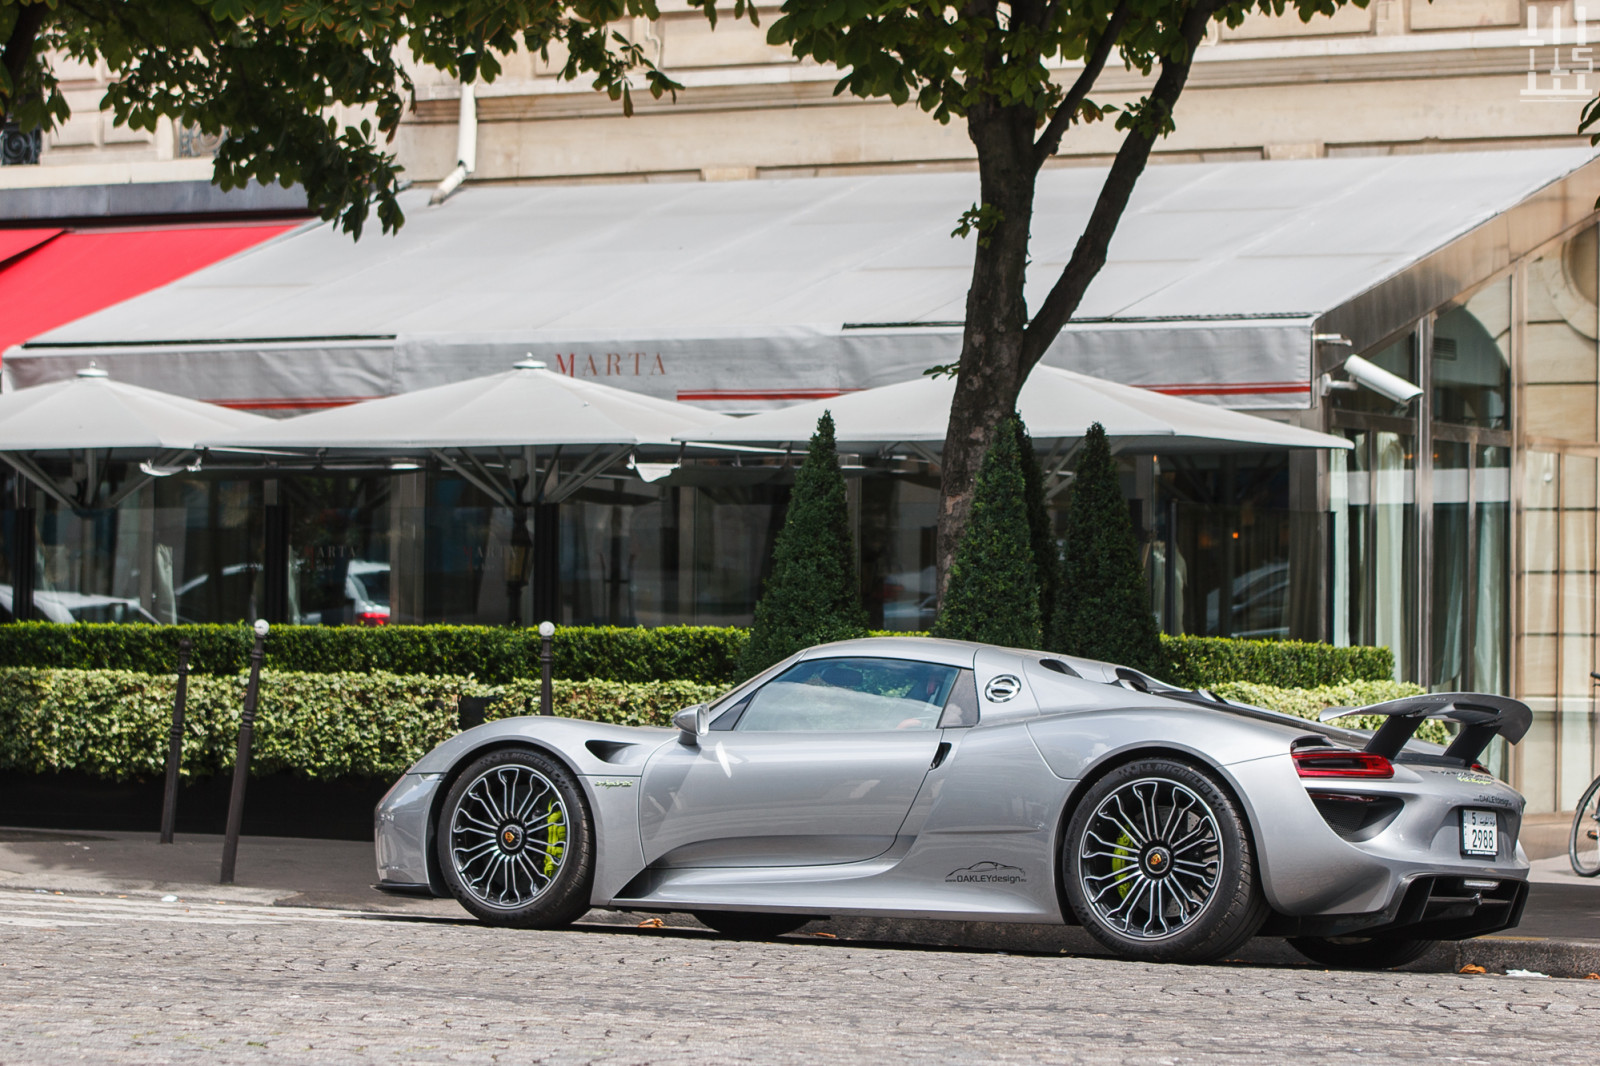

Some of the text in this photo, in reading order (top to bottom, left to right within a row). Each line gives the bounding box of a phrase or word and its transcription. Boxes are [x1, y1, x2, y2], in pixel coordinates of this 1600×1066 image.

[555, 352, 667, 378] MARTA
[511, 753, 554, 775] MICHELIN
[1154, 763, 1212, 794] MICHELIN
[1472, 811, 1477, 826] 5
[1472, 829, 1494, 849] 2988
